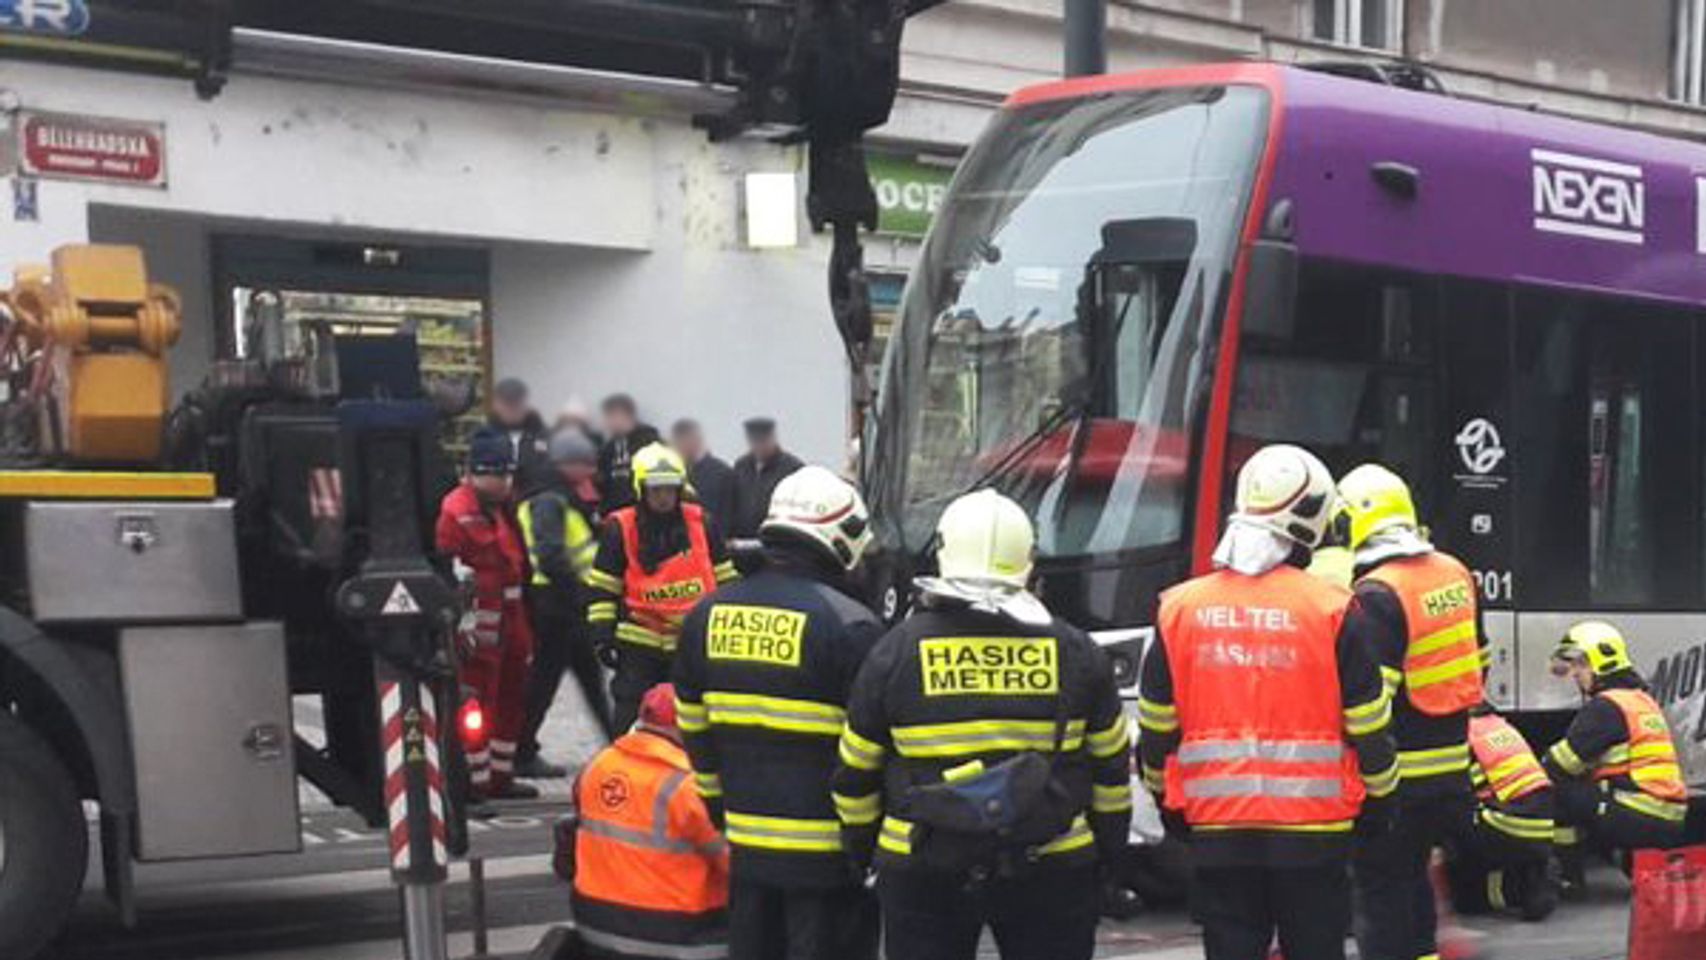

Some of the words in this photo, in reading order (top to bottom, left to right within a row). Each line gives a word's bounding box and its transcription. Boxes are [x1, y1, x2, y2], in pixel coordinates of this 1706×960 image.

[1533, 164, 1643, 228] NEXEN
[713, 611, 799, 638] HASICI
[1196, 605, 1297, 631] VELTEL
[711, 634, 794, 661] METRO
[928, 645, 1051, 666] HASICI
[930, 668, 1052, 690] METRO
